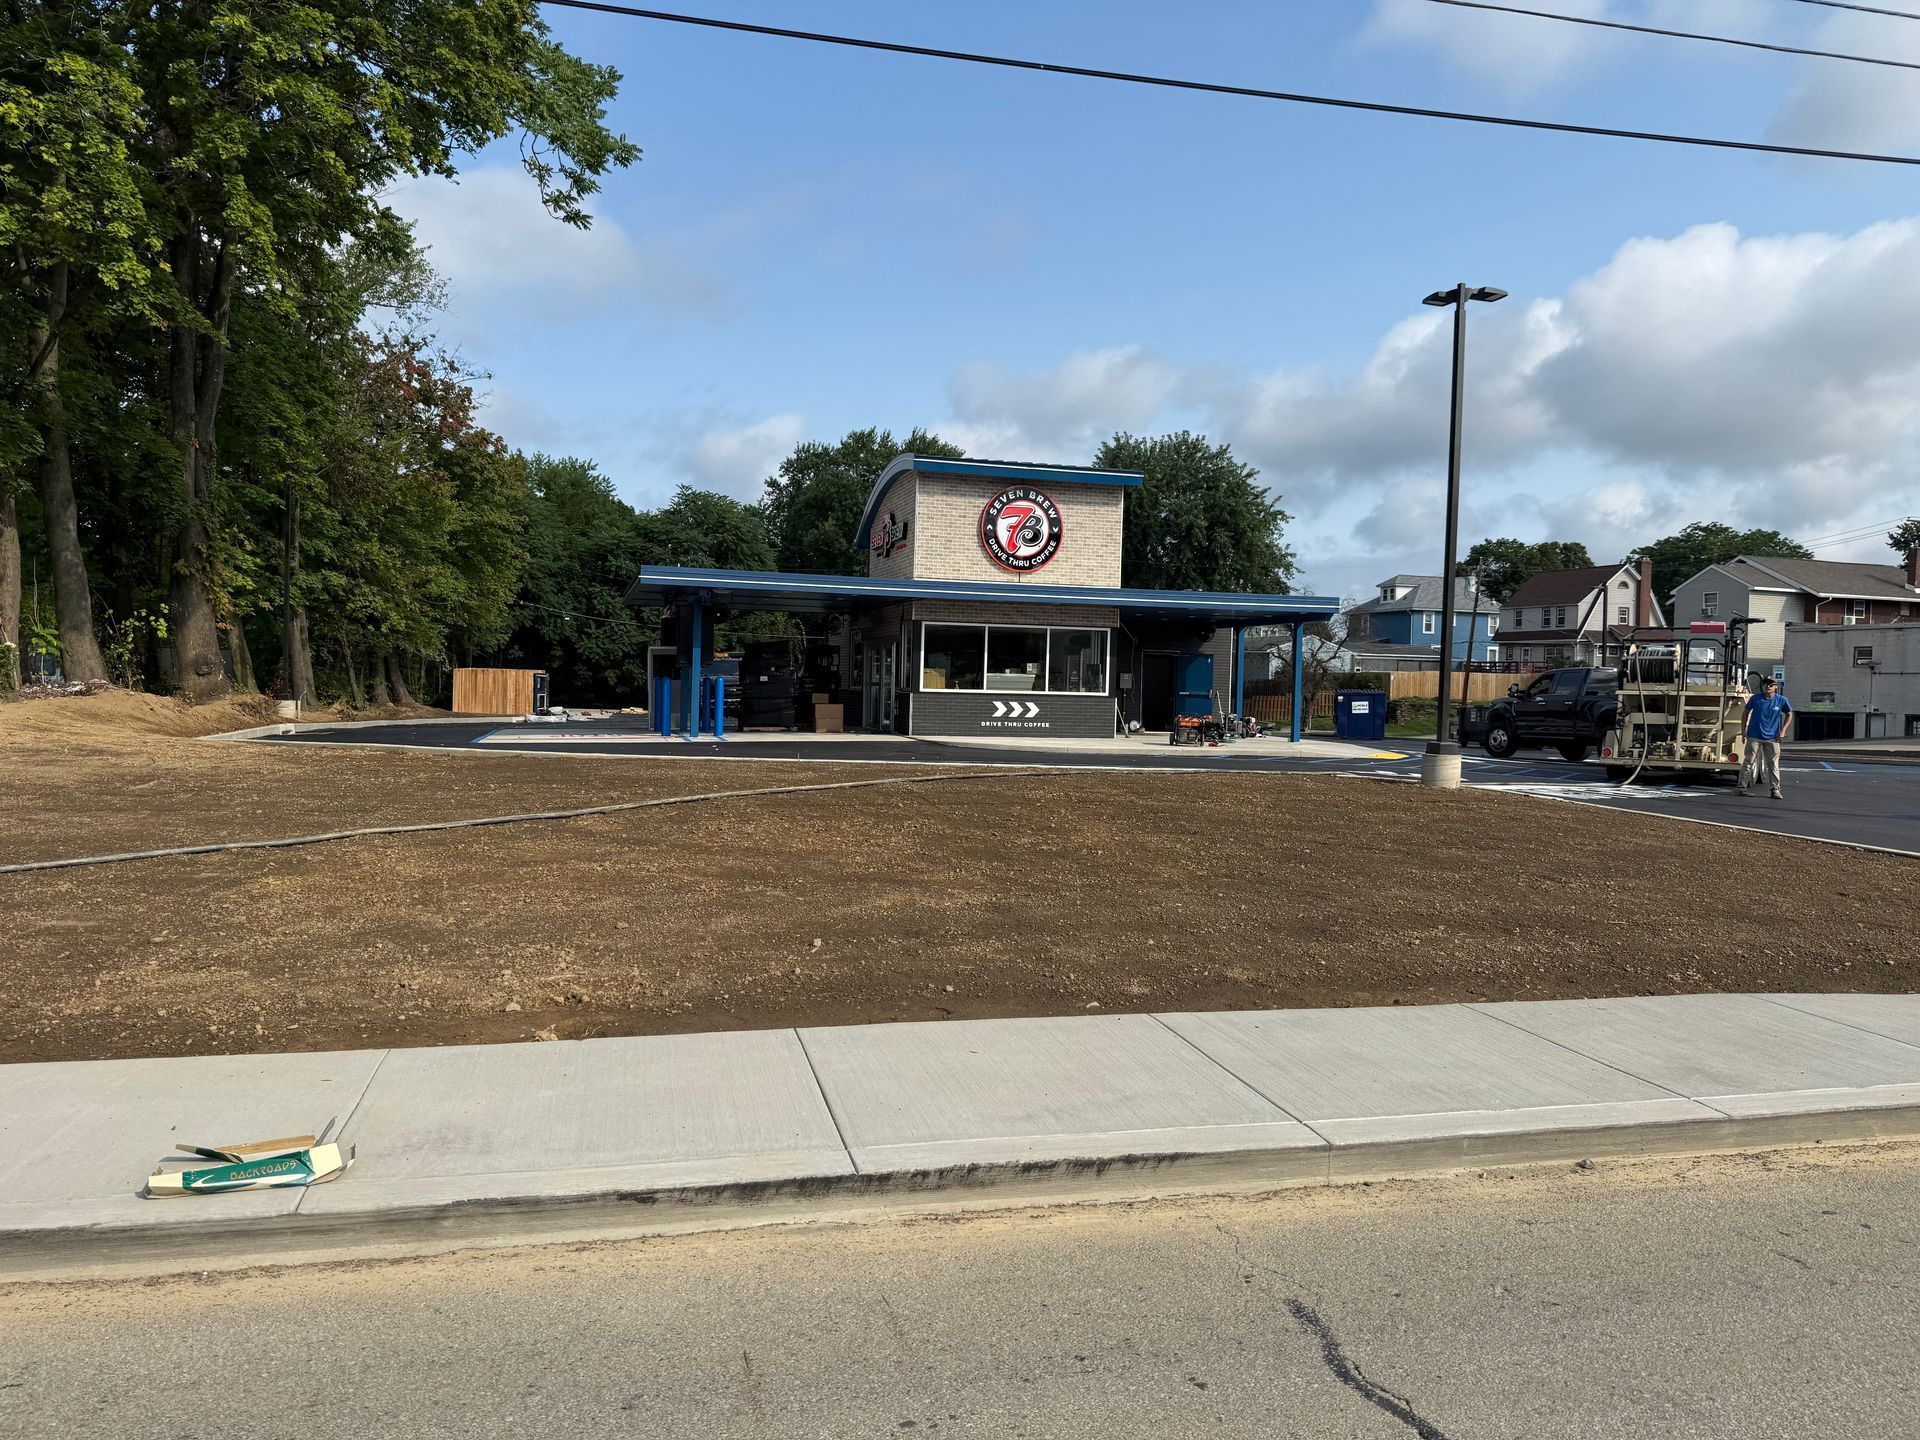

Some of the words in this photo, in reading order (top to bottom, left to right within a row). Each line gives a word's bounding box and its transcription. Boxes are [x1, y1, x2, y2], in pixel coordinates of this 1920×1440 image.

[990, 490, 1024, 516] SEVEN
[1029, 491, 1058, 519] BREW
[988, 538, 1008, 561] DRIVE
[1008, 557, 1030, 567] THRU
[1031, 540, 1057, 565] COFFEE
[230, 1160, 296, 1180] BACKROADS
